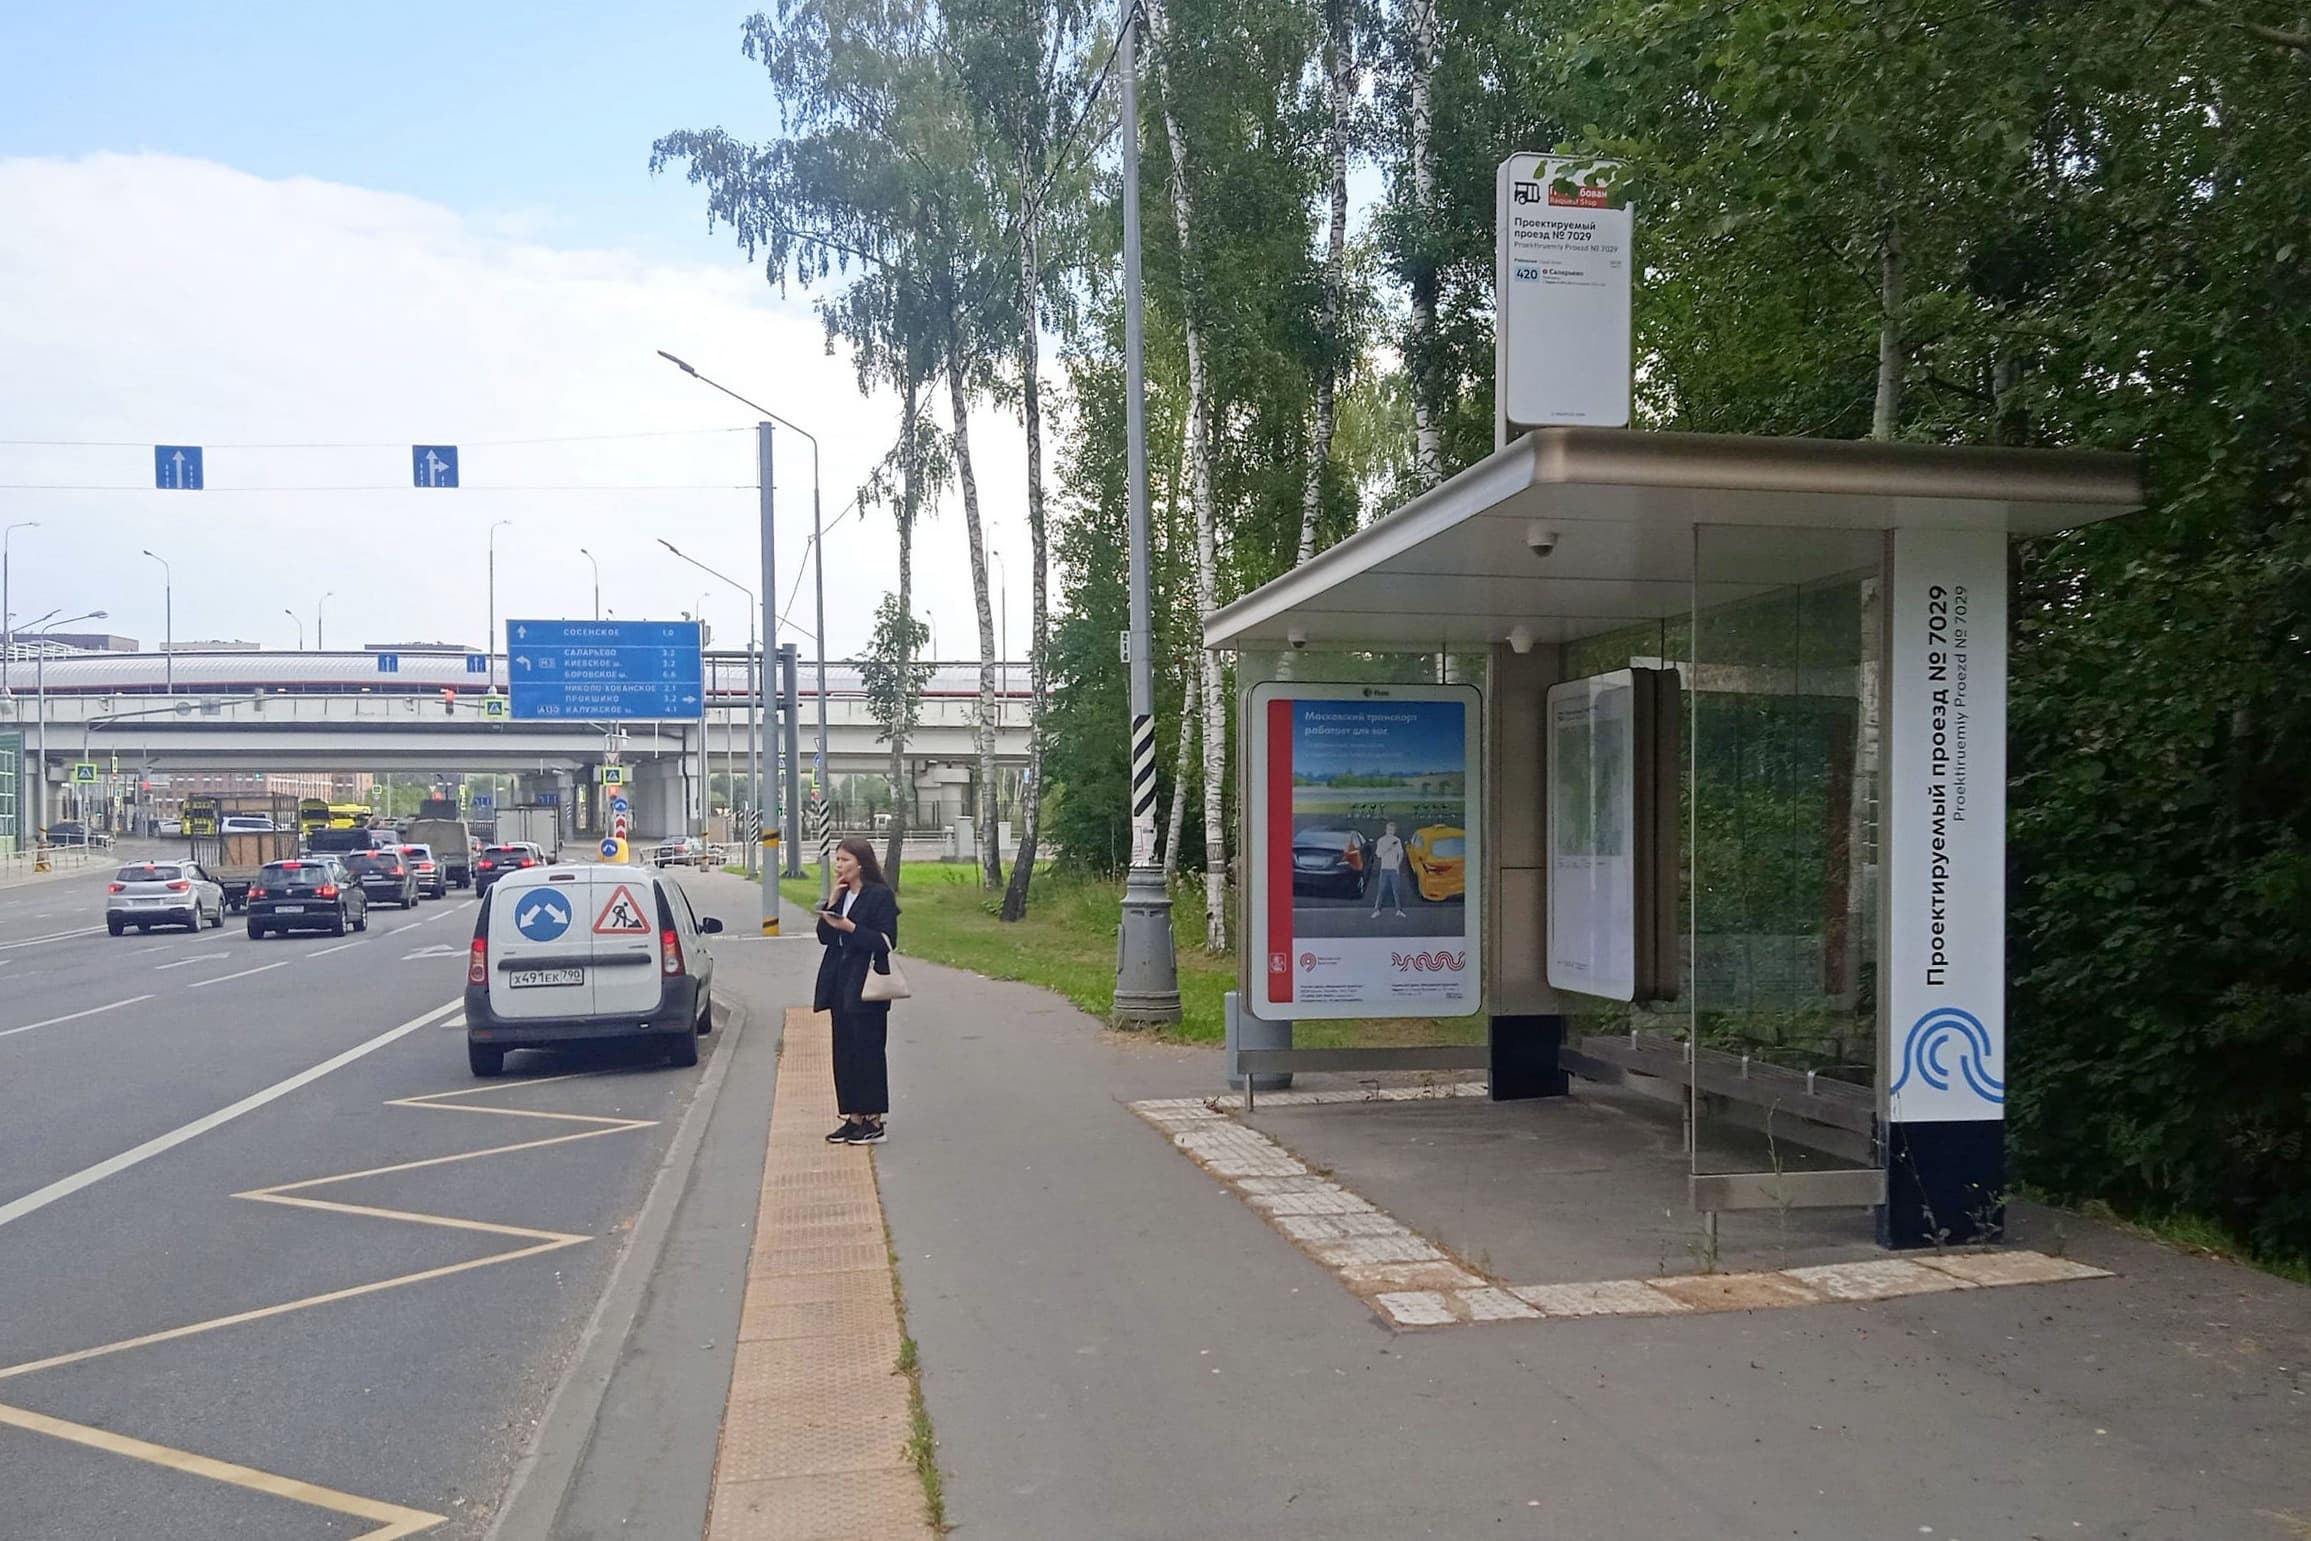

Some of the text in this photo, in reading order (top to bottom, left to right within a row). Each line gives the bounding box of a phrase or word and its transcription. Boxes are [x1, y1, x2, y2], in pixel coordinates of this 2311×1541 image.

[1579, 187, 1608, 198] бован
[1580, 198, 1598, 207] Stop
[1514, 217, 1596, 231] Проектируемый
[1514, 230, 1592, 241] проезд № 7029
[1516, 269, 1538, 280] 420
[563, 628, 619, 636] СОСЕНСКОЕ
[565, 671, 617, 679] БОРОВСКОЕ
[565, 695, 619, 703] ПРОКШИНО
[1953, 585, 1968, 821] Proektiruemiy Proezd № 7029
[566, 706, 622, 714] КАЛУЖСКОЕ
[1305, 711, 1417, 724] Московский транспорт
[1305, 725, 1350, 736] работает
[1352, 727, 1369, 736] для
[1927, 585, 1950, 986] Проектируемый проезд № 7029
[562, 970, 580, 979] 790
